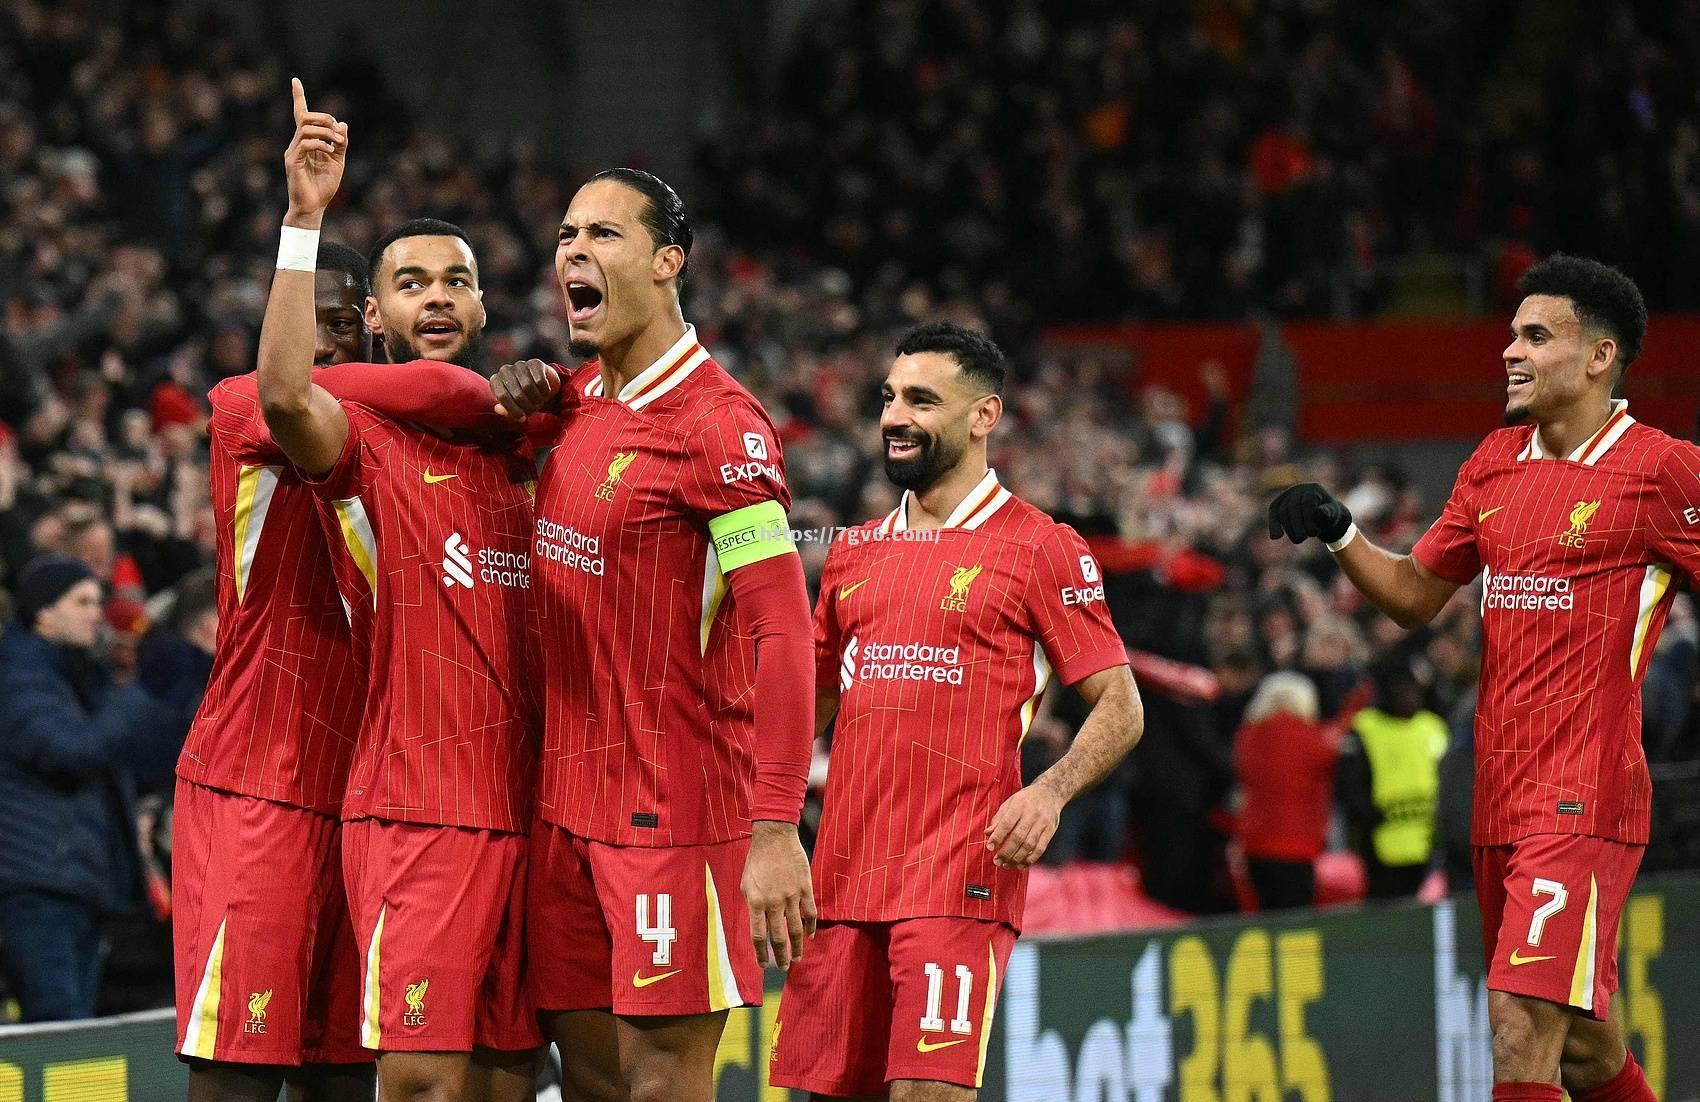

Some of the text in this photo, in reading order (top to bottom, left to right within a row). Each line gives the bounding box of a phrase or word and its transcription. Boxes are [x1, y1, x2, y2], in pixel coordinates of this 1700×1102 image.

[536, 517, 599, 555] standard
[536, 538, 604, 576] chartered
[1061, 582, 1105, 606] Expe
[1491, 573, 1570, 593] standard
[1487, 591, 1574, 611] chartered
[862, 641, 960, 664] standard
[860, 661, 964, 685] chartered
[1527, 877, 1569, 947] 7
[635, 893, 678, 967] 4
[920, 962, 974, 1036] 11
